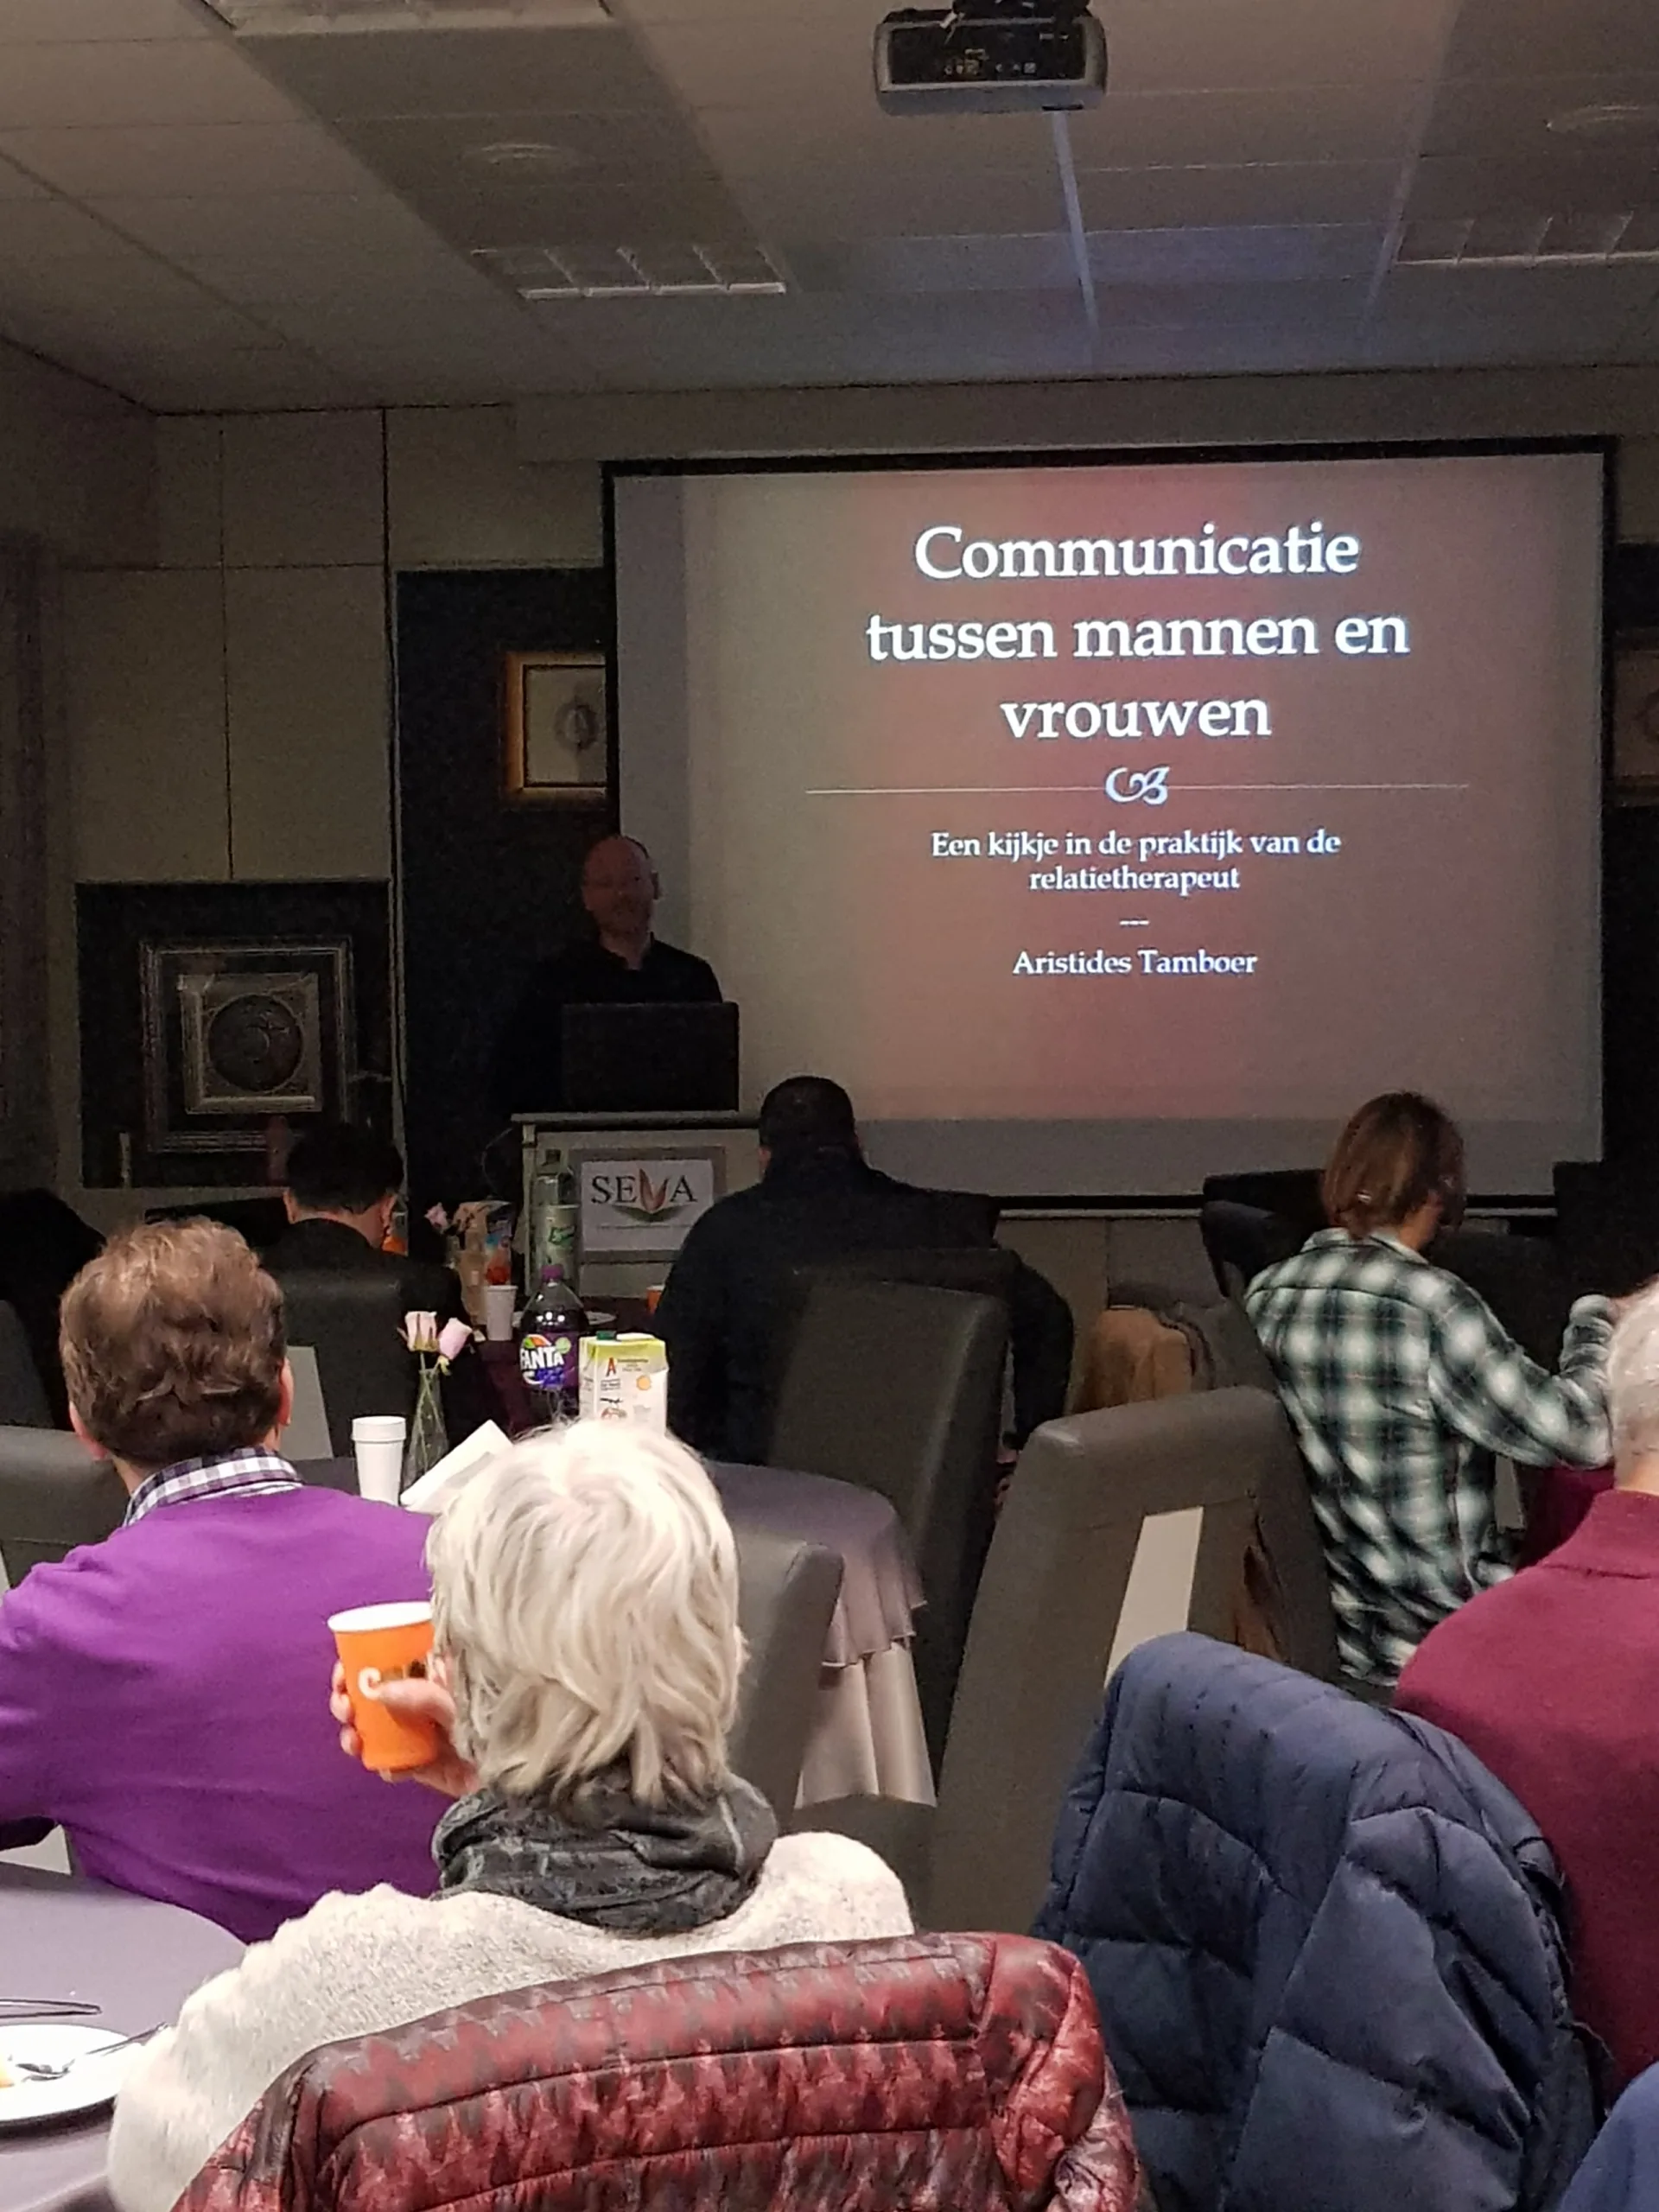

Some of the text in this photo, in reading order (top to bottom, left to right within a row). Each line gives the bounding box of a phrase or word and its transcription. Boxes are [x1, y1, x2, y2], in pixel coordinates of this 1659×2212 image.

[915, 519, 1360, 580] Communicatie
[866, 614, 1412, 662] tussen mannen en
[1000, 699, 1274, 741] vrouwen
[931, 828, 1344, 864] Een kijkje in de praktijk van de
[1029, 864, 1242, 897] relatietherapeut
[1013, 949, 1259, 976] Aristides Tamboer
